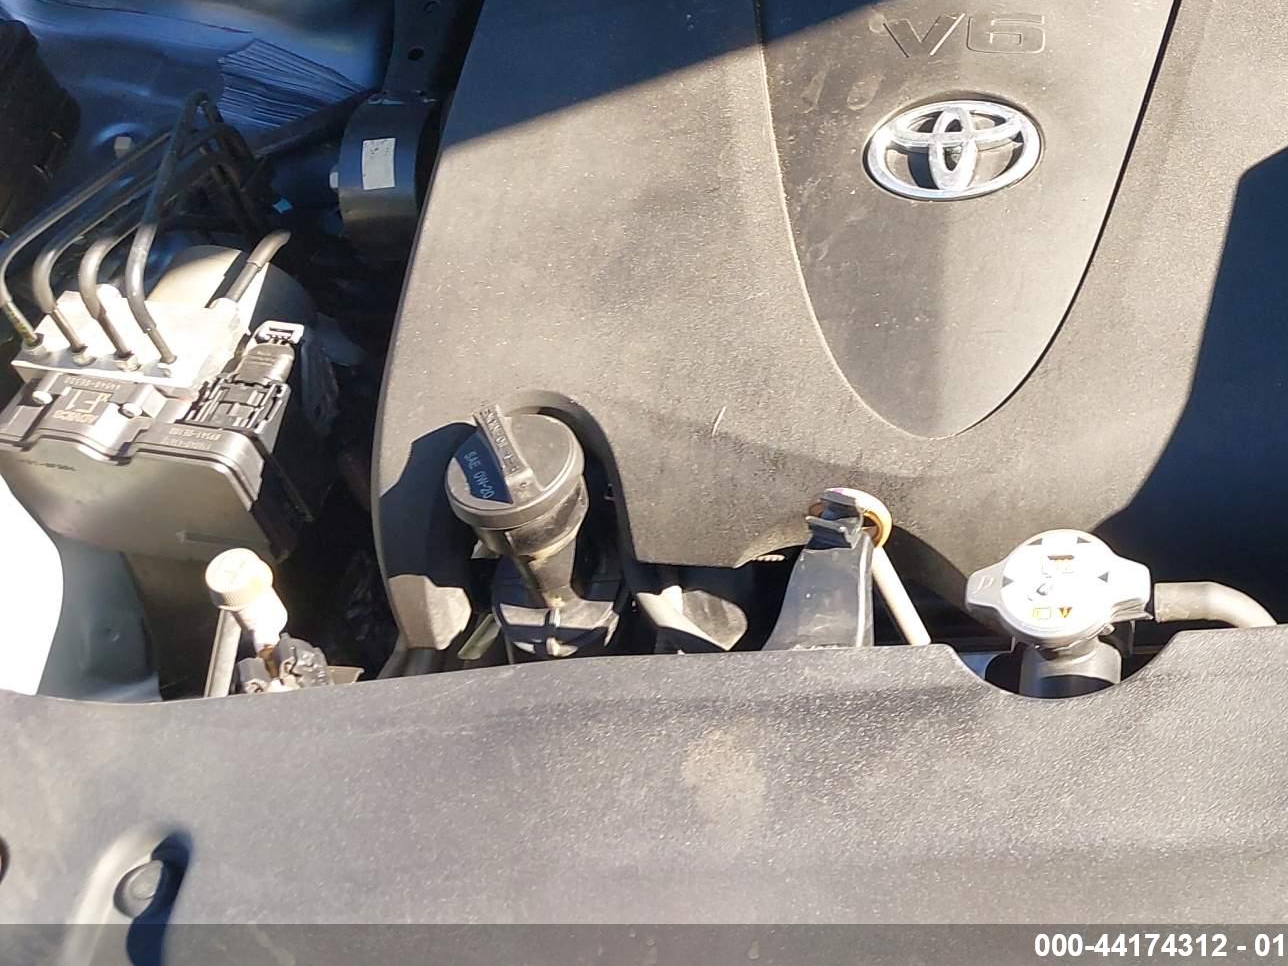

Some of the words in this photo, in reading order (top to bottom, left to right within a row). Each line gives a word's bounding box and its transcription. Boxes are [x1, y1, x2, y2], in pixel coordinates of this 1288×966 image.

[884, 13, 1046, 58] V6
[464, 451, 480, 470] SAE
[473, 470, 495, 498] 0W-20
